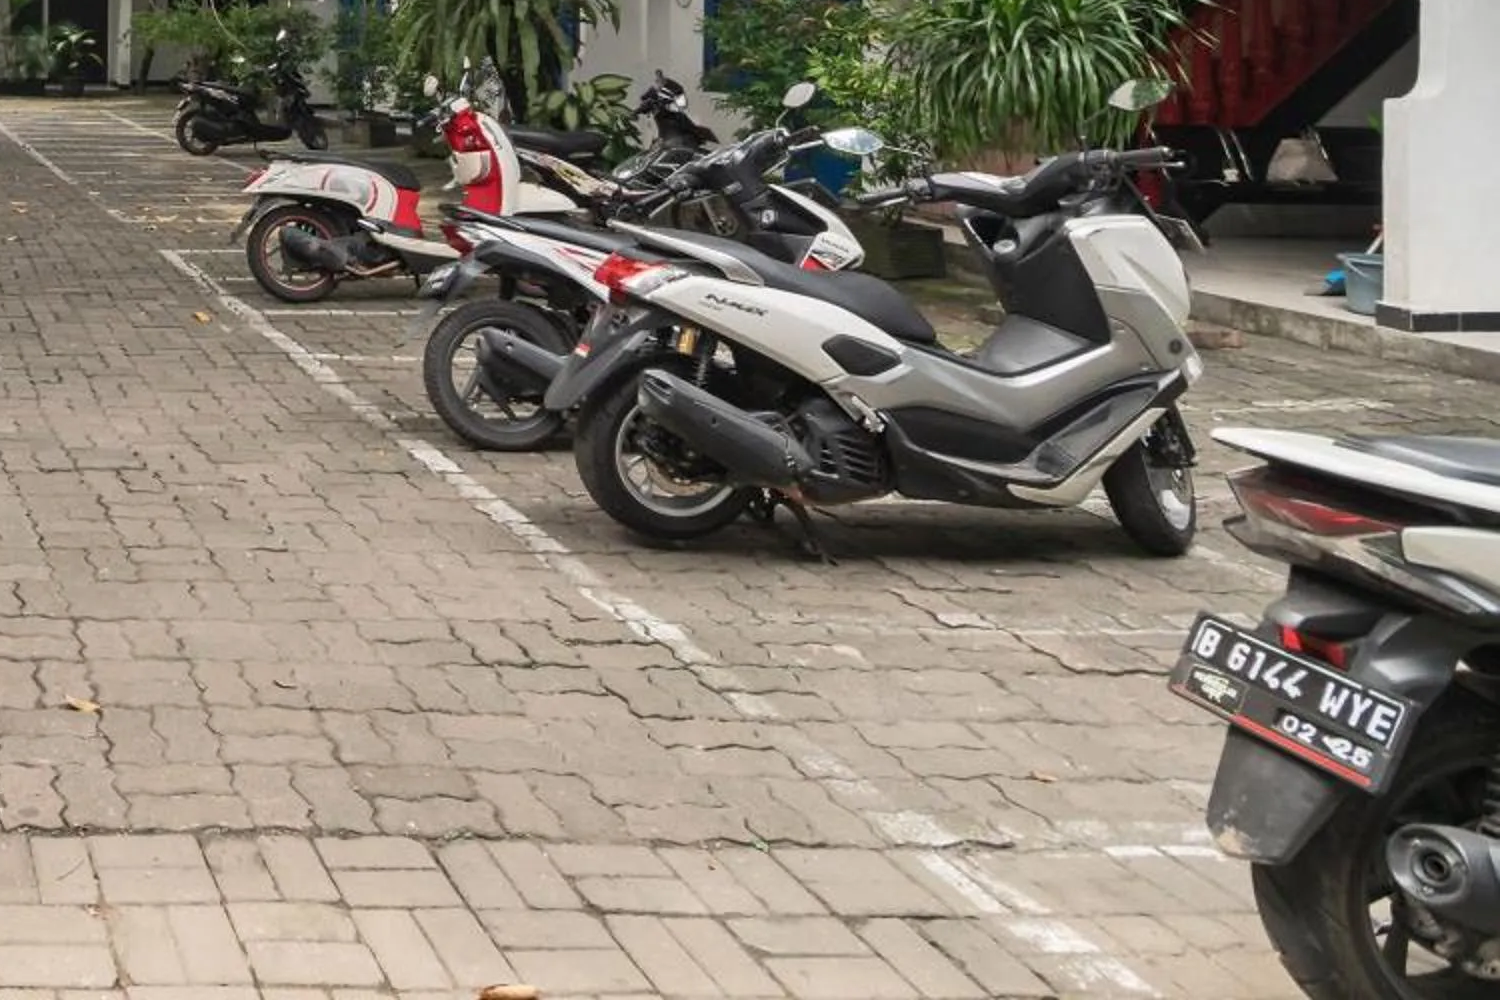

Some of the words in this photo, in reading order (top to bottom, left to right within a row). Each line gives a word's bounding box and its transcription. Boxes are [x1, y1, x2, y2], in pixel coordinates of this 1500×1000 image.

[1198, 628, 1221, 657] B
[1227, 642, 1308, 699] 6144
[1319, 681, 1397, 741] WYE
